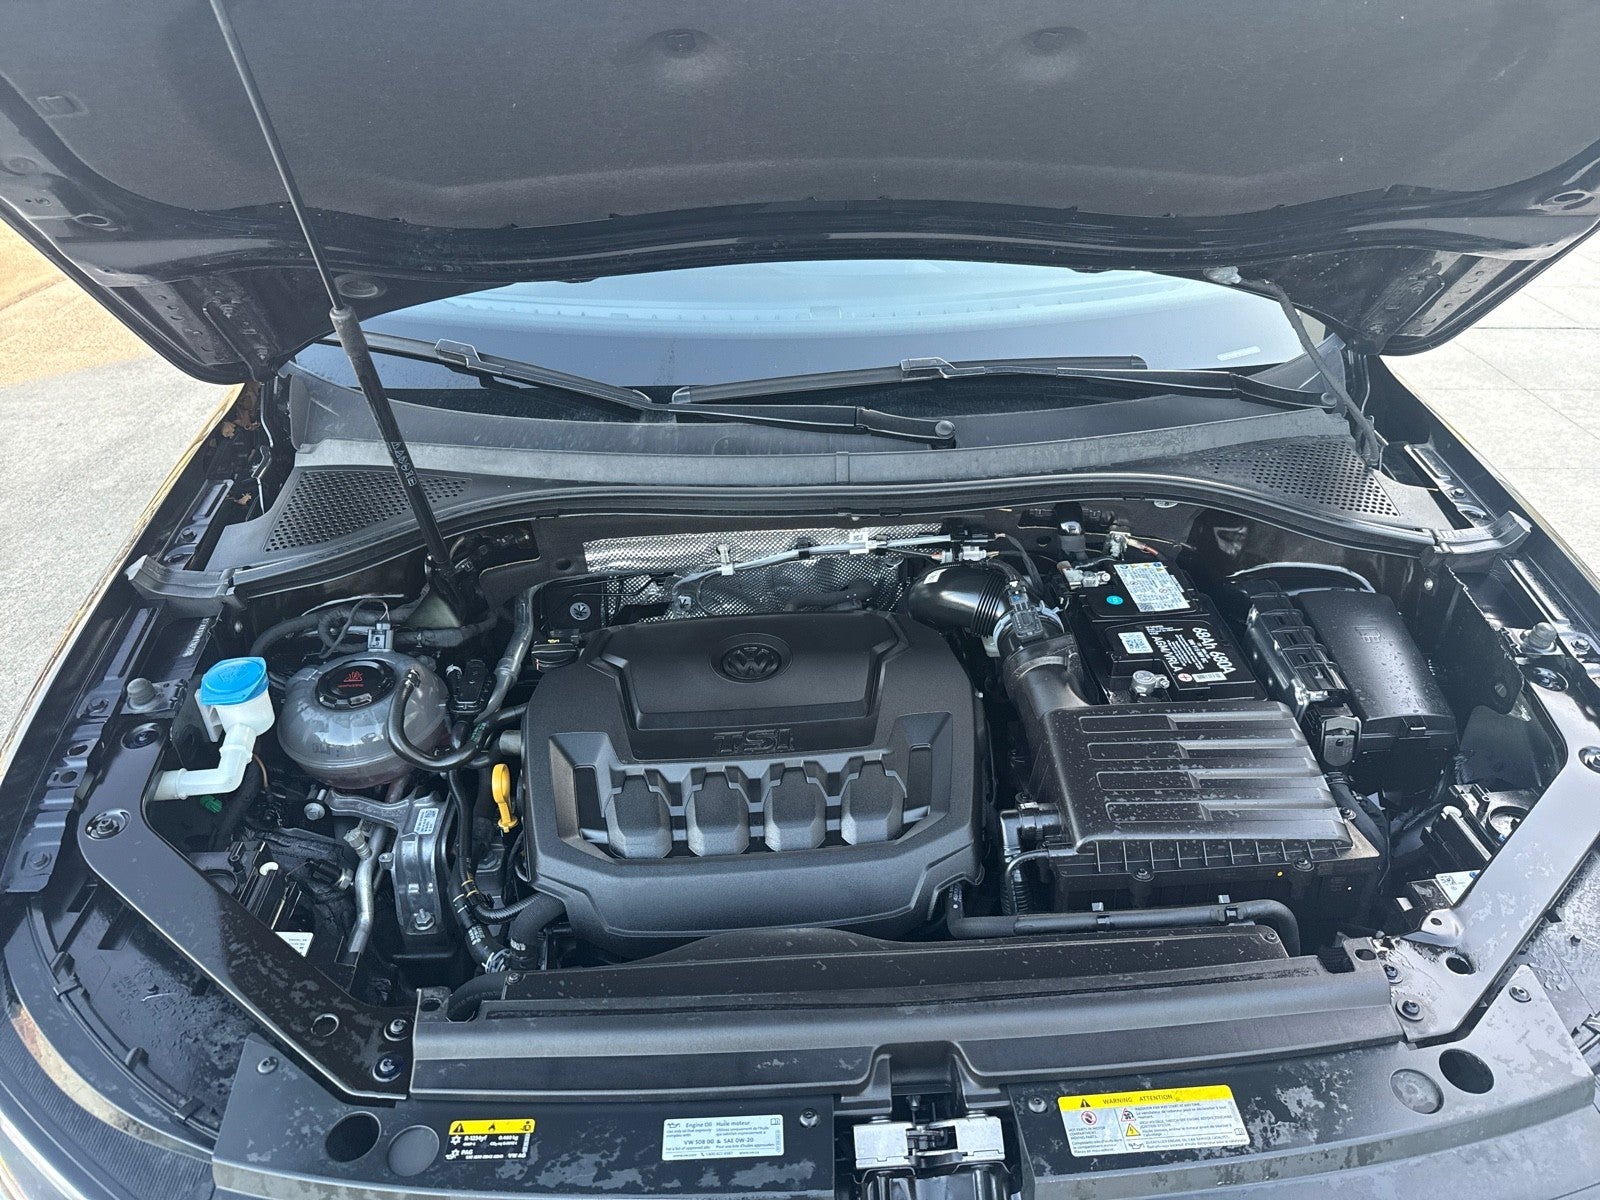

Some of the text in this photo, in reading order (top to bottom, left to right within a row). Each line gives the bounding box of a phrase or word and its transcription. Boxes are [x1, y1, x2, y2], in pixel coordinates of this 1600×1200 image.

[1152, 636, 1183, 672] AGM/VRLA
[1192, 627, 1237, 674] 68Ah 680A
[713, 729, 793, 753] TSI
[1103, 1097, 1133, 1105] WARNING
[1139, 1094, 1173, 1102] ATTENTION
